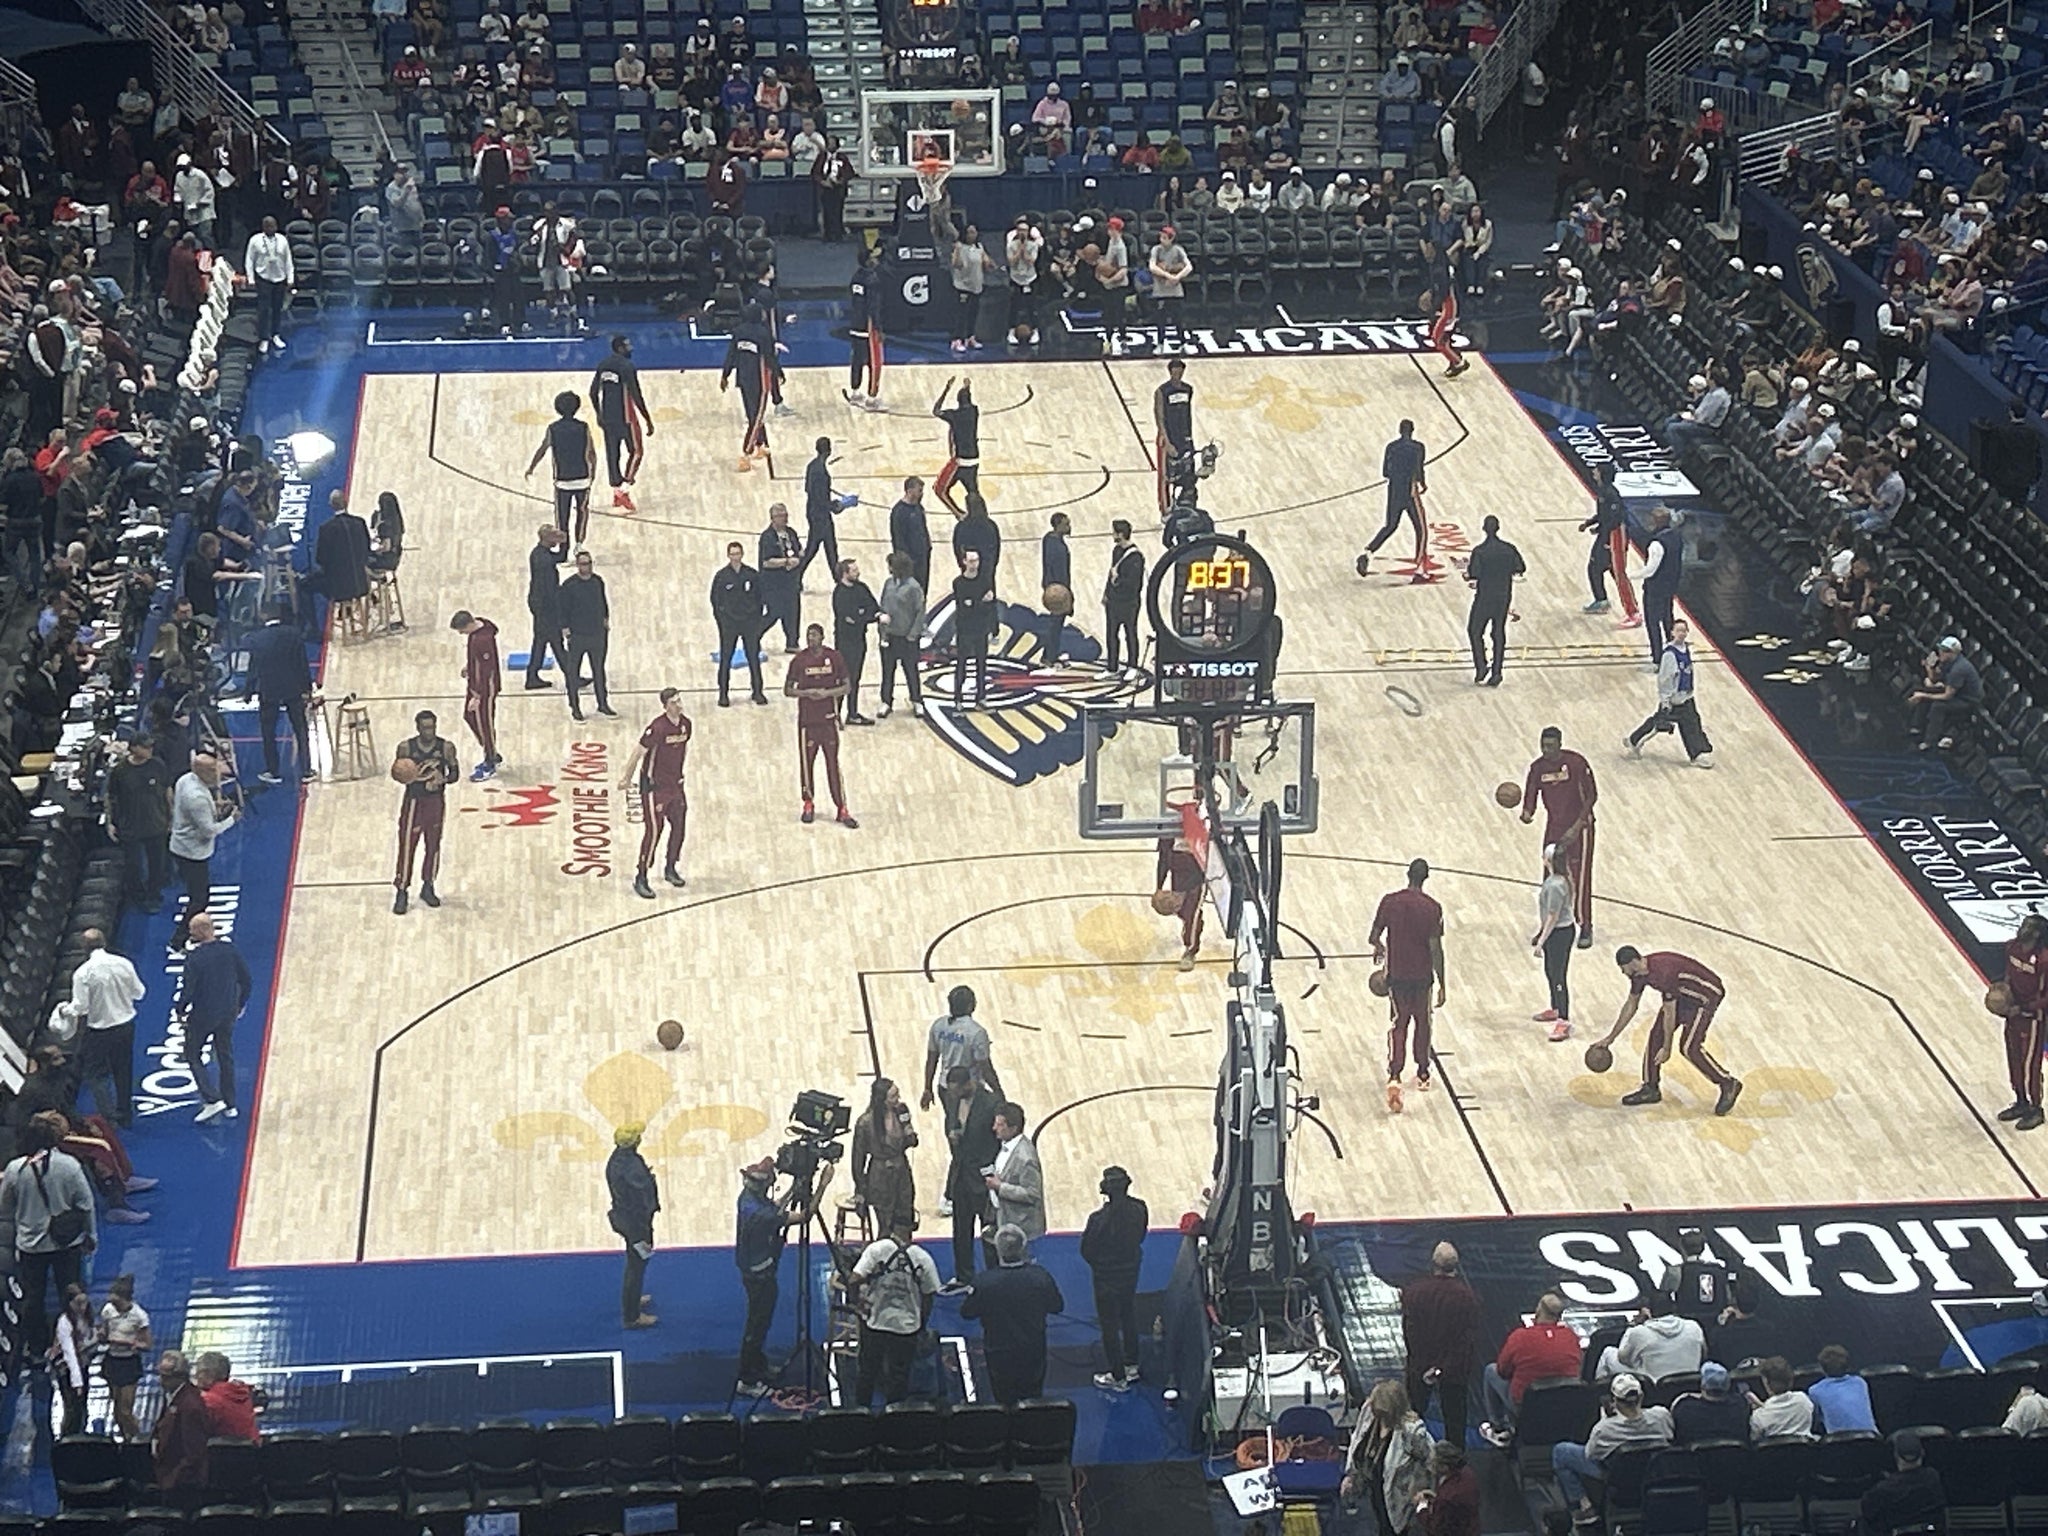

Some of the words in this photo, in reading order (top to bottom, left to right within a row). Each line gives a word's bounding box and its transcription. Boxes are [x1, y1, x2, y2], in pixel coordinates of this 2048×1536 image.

[903, 274, 929, 305] G
[1189, 662, 1259, 677] TISSOT
[560, 787, 612, 878] SMOOTHIE
[1882, 817, 1986, 902] MORRIS
[1931, 814, 2048, 899] BART
[1538, 1215, 2048, 1304] LICANS
